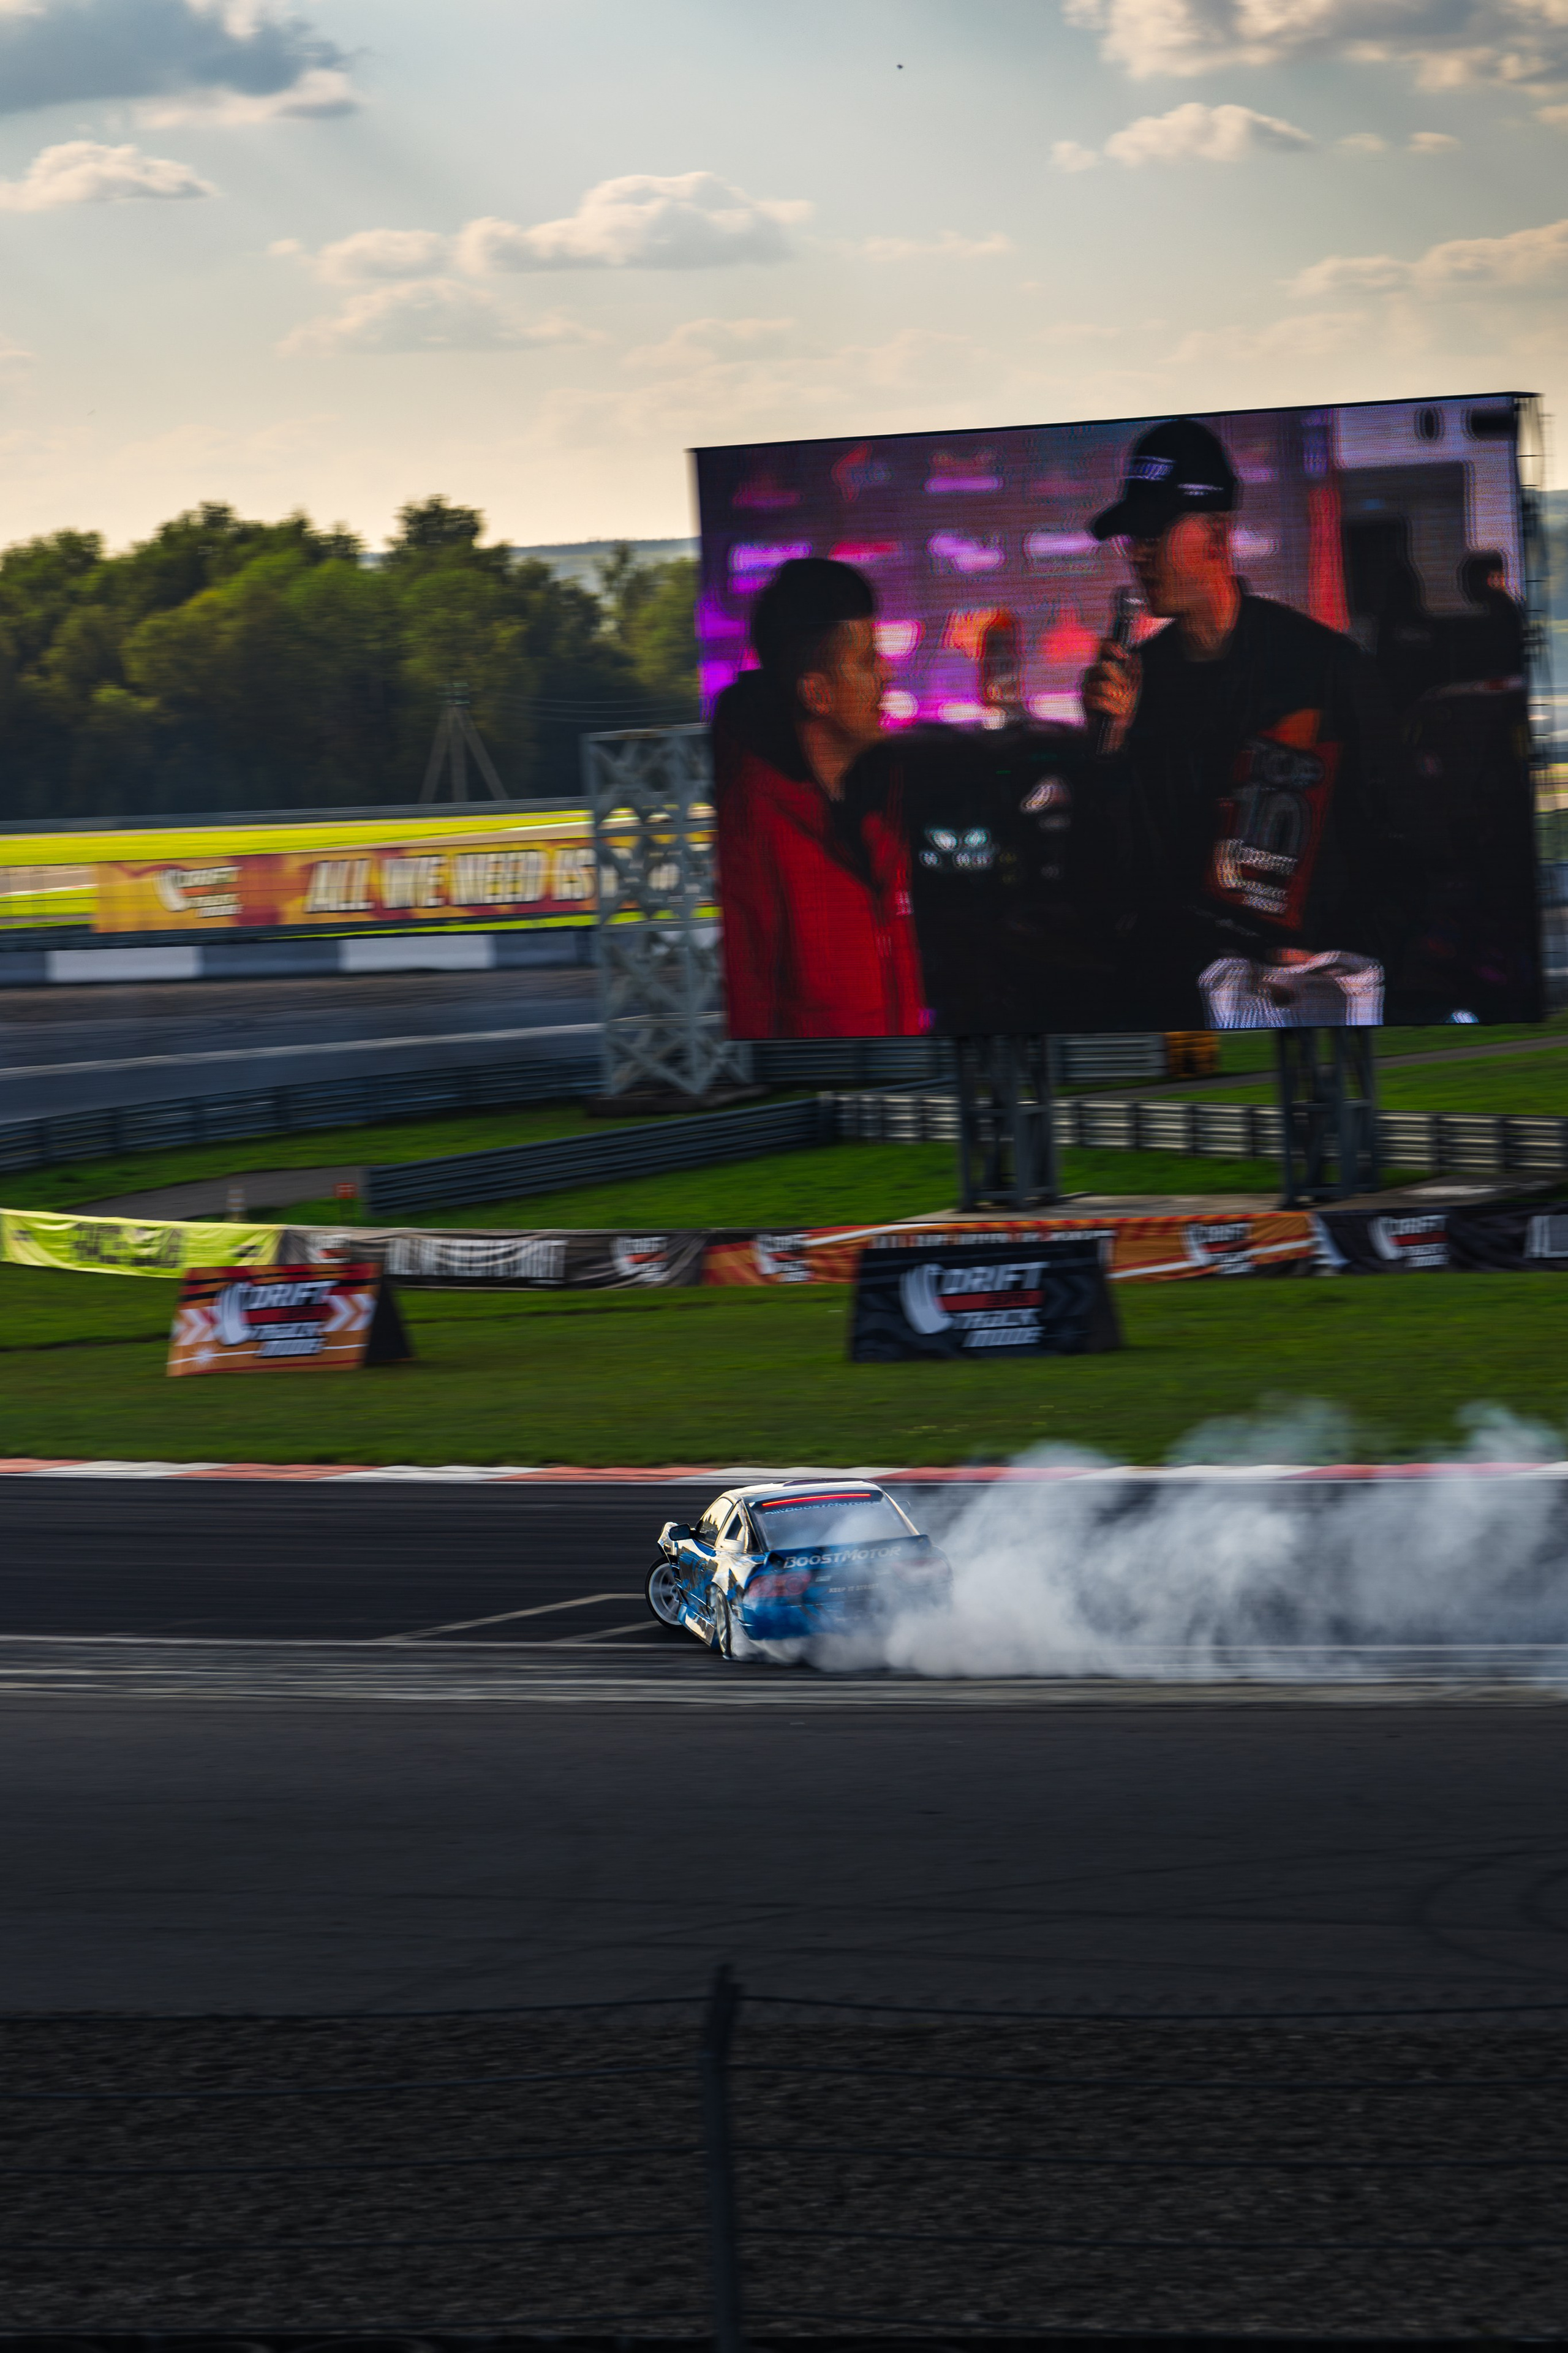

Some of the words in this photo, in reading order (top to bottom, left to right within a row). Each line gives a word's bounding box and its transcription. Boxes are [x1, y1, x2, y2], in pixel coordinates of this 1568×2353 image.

[304, 859, 375, 913] ALL
[382, 855, 447, 908] WE
[450, 850, 548, 906] NEED
[247, 1280, 339, 1310] DRIFT
[940, 1261, 1050, 1295] DRIFT
